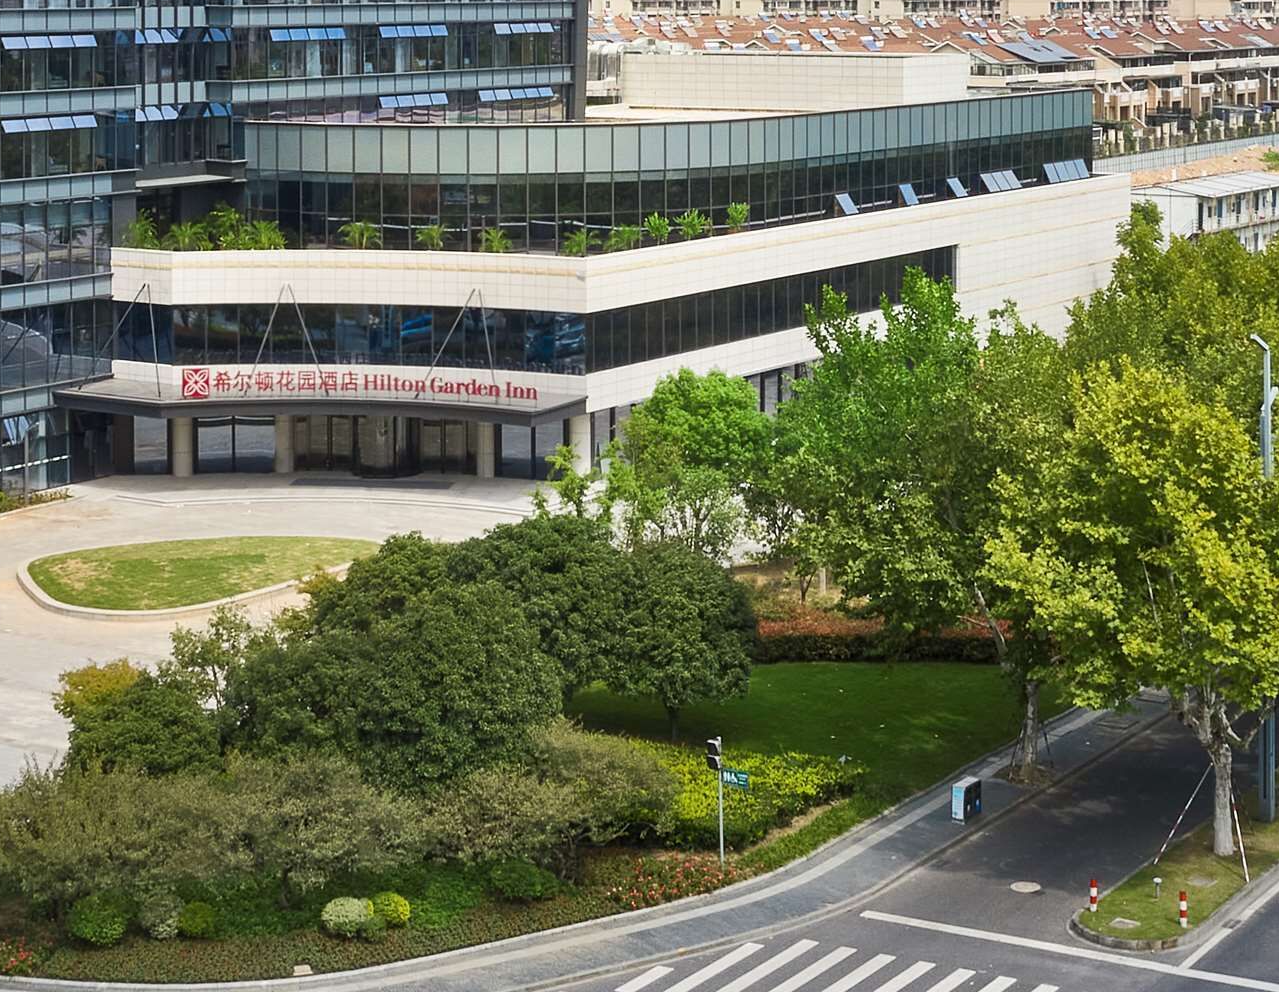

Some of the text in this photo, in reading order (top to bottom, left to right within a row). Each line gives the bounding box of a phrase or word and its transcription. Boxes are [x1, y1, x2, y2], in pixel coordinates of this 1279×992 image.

[213, 370, 538, 401] 希尔顿花园酒店 Hilton Garden Inn
